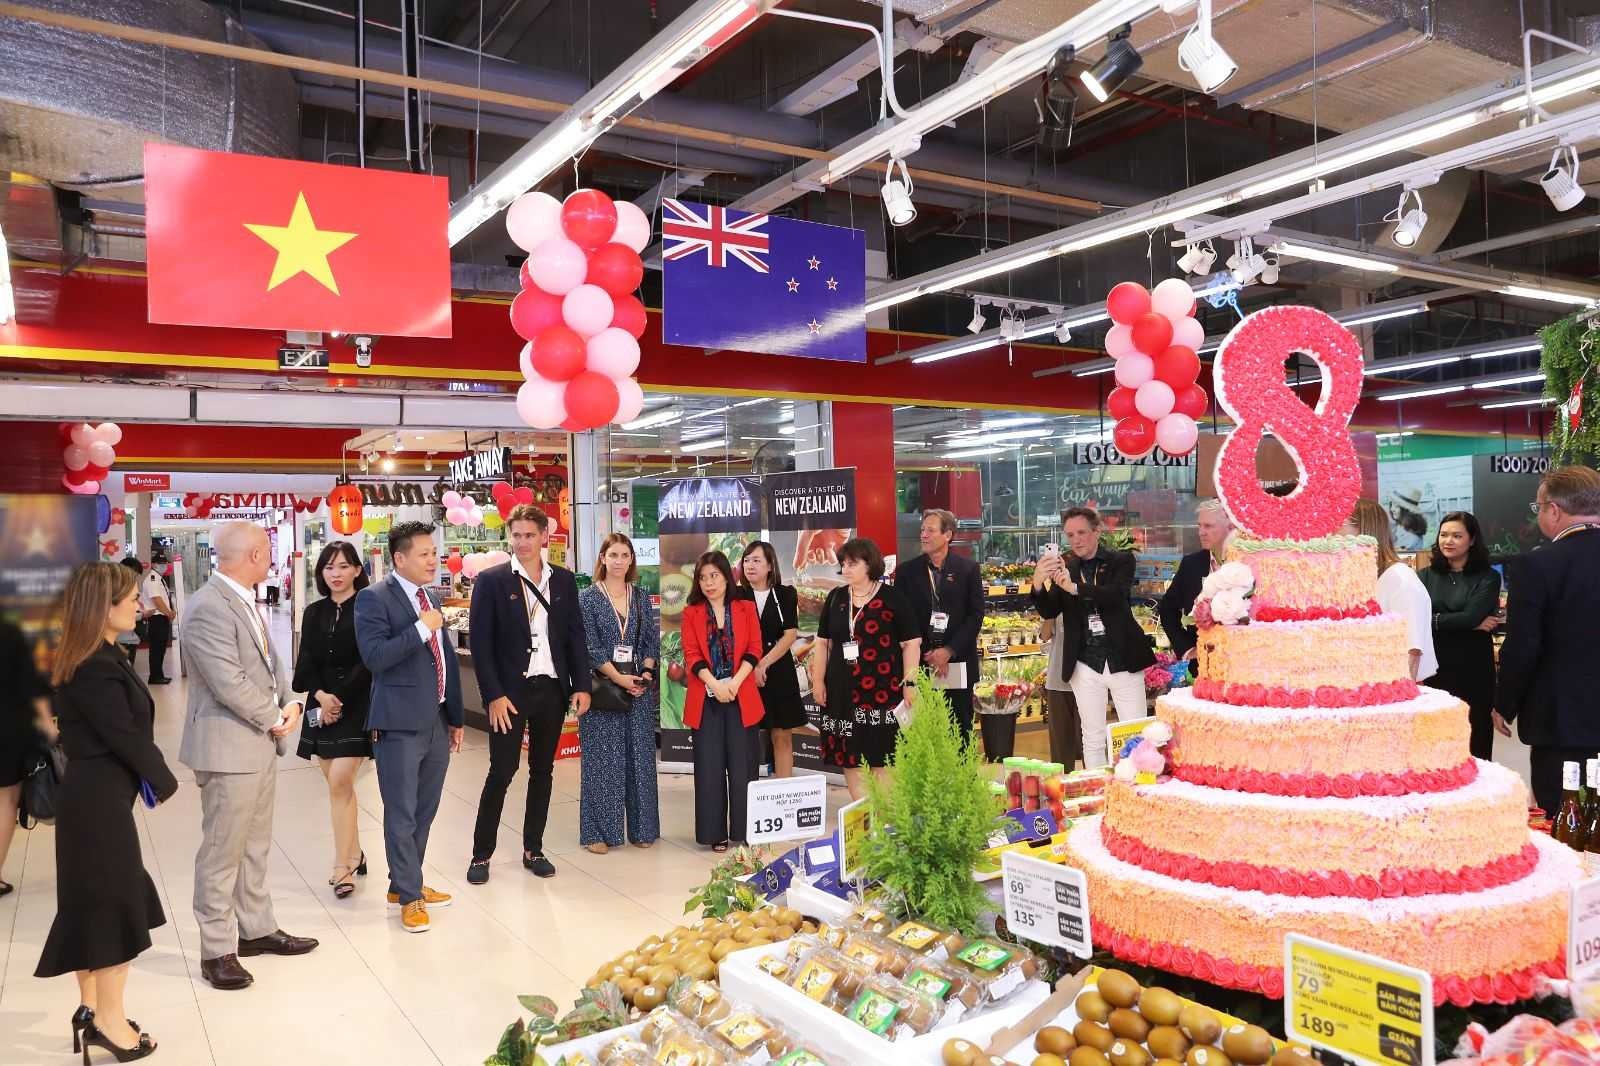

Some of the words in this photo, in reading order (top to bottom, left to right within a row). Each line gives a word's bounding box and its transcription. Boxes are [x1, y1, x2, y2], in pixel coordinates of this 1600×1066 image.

[285, 351, 324, 366] EXIT
[1213, 305, 1364, 542] 8
[448, 456, 474, 484] TAKE
[475, 447, 504, 479] AWAY
[1495, 455, 1530, 473] FOOD
[774, 487, 807, 496] DISCOVER
[814, 485, 835, 494] TASTE
[668, 501, 695, 519] NEW
[696, 500, 752, 518] ZEALAND
[775, 497, 798, 516] NEW
[799, 494, 847, 515] ZEALAND
[754, 817, 783, 834] 139
[1010, 880, 1024, 894] 69
[1014, 909, 1035, 927] 135
[1297, 972, 1319, 993] 79
[1300, 1012, 1335, 1037] 189
